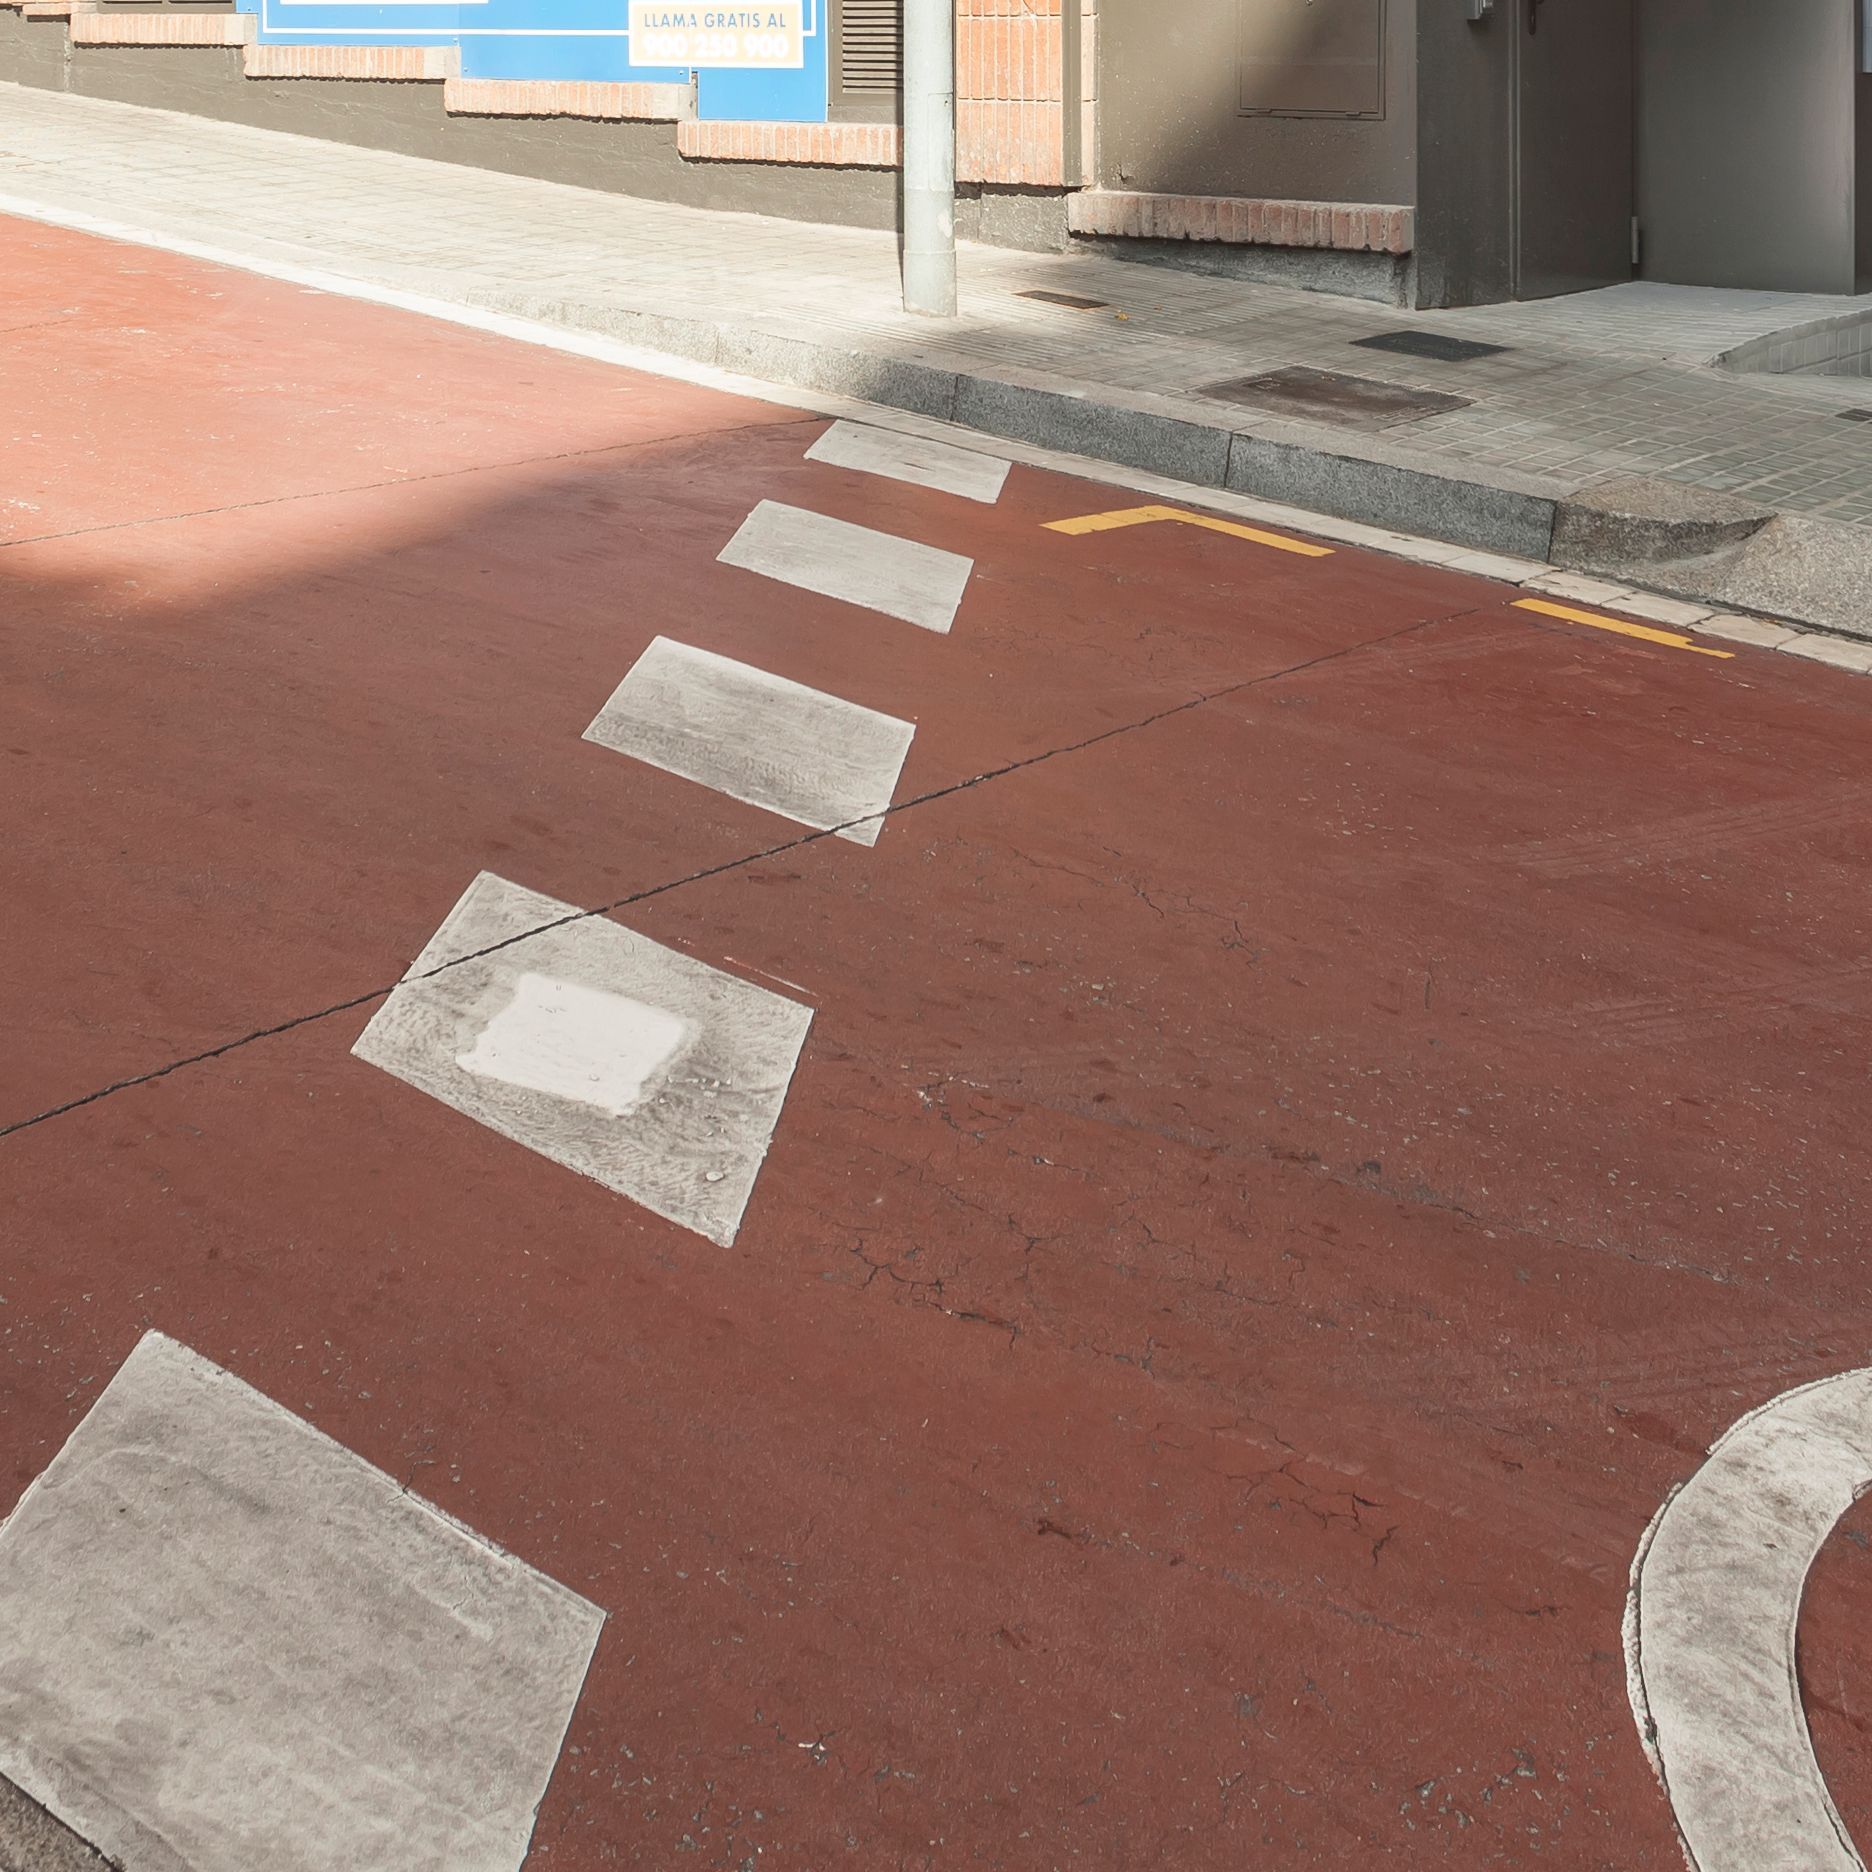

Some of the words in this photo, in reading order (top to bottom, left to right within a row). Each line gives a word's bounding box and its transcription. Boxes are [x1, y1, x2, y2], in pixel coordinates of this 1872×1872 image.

[644, 12, 698, 28] LLAMA
[704, 12, 761, 28] GRATIS
[767, 12, 787, 28] AL
